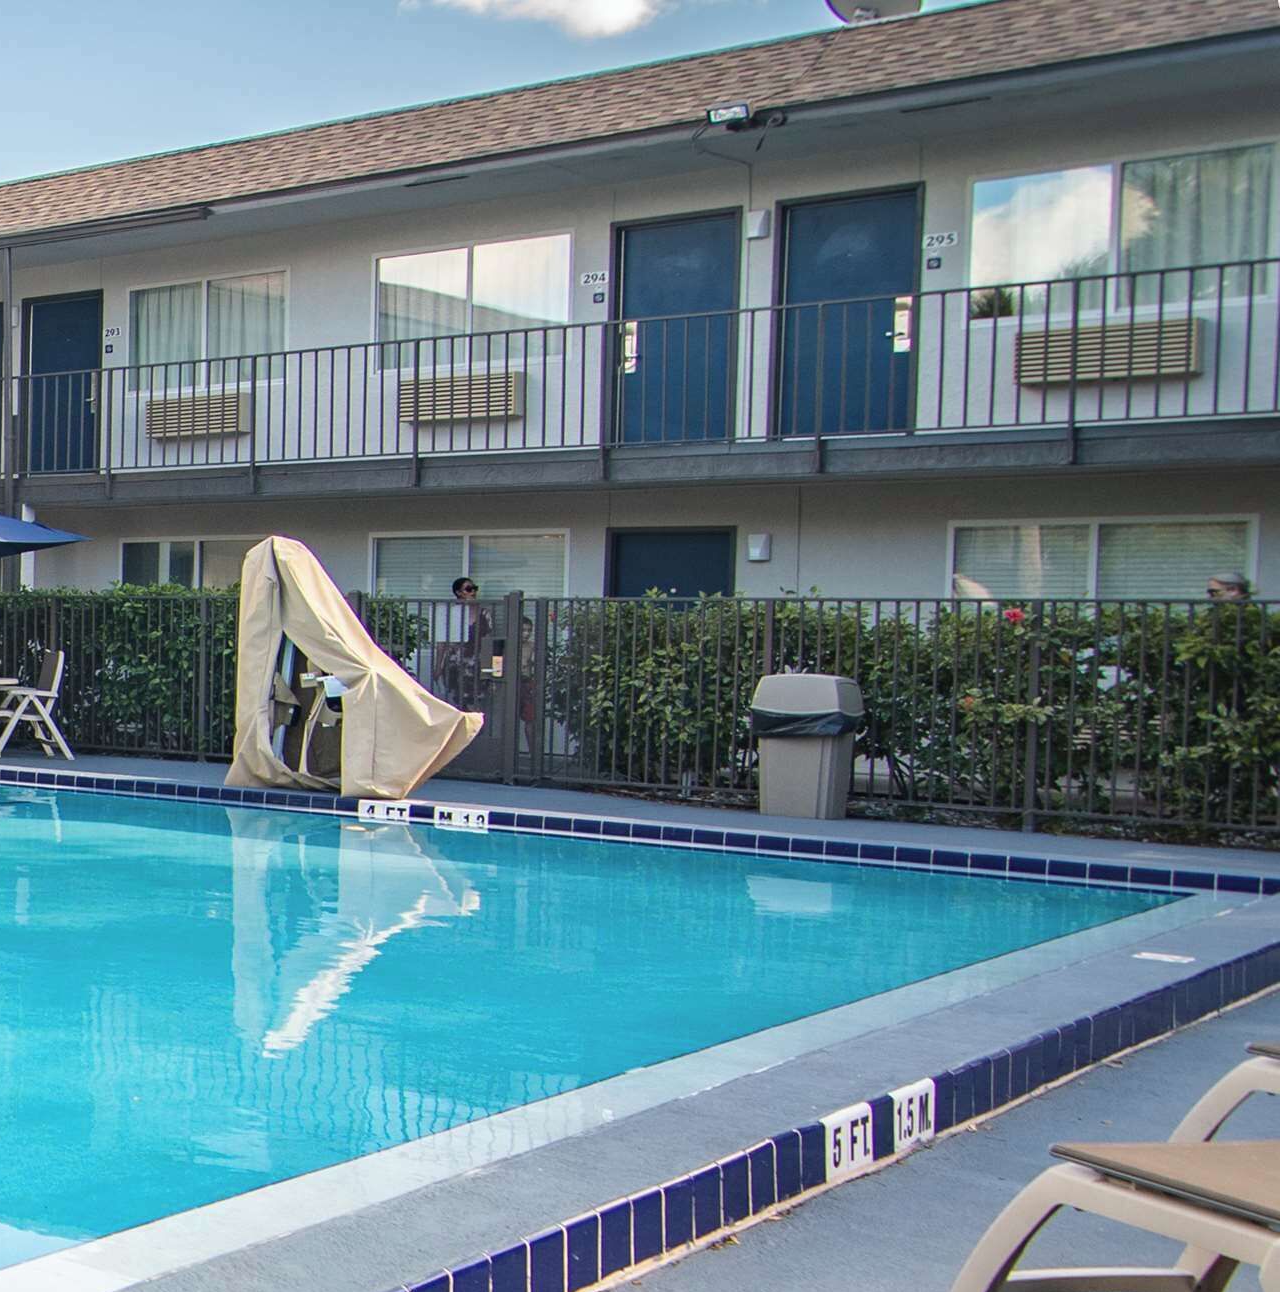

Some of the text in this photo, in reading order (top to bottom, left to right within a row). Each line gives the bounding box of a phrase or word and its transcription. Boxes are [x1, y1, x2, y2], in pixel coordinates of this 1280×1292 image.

[927, 233, 954, 247] 295
[583, 272, 606, 285] 294
[897, 1097, 914, 1141] 1.5
[833, 1127, 841, 1168] 5
